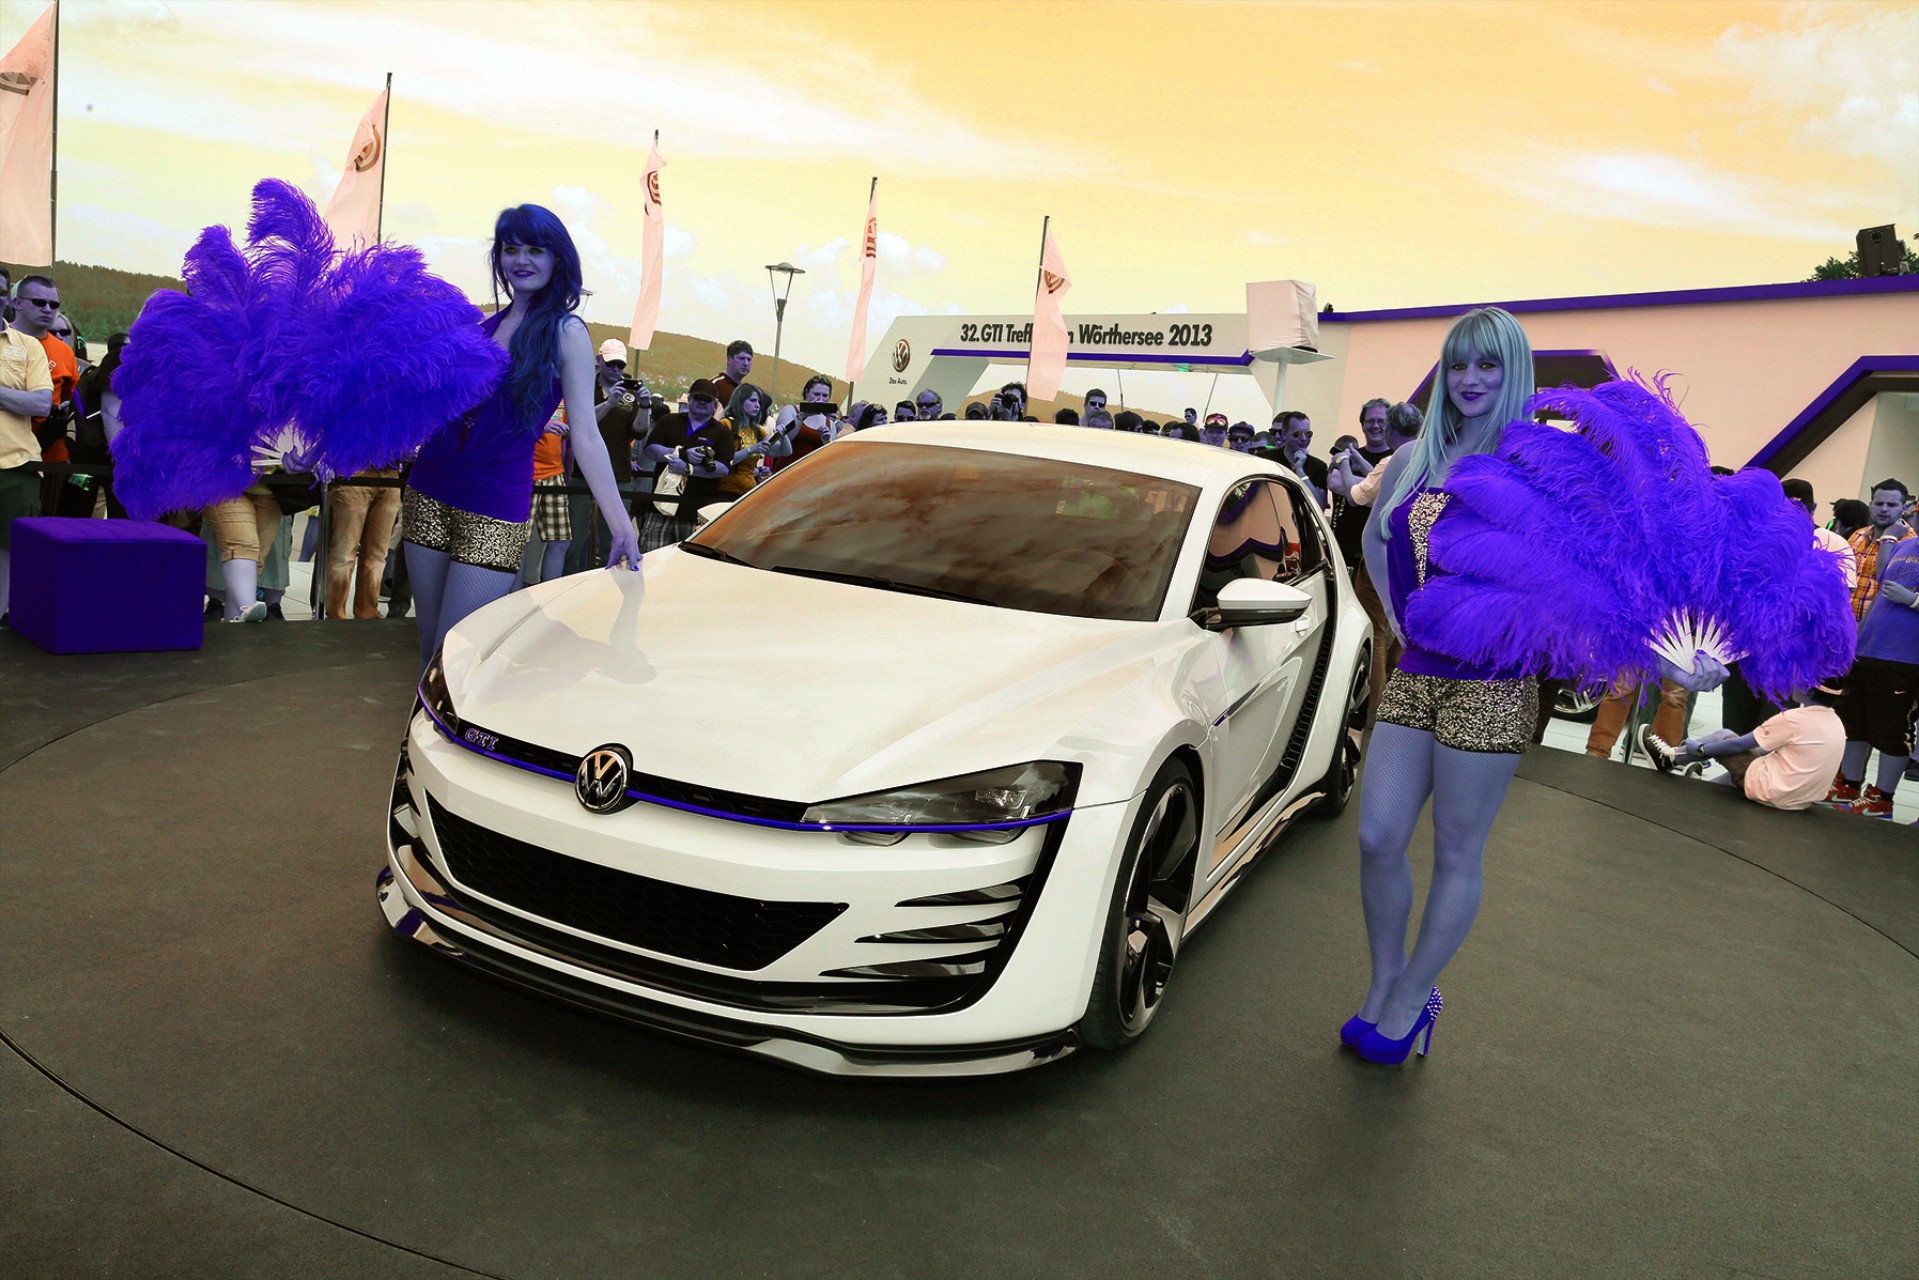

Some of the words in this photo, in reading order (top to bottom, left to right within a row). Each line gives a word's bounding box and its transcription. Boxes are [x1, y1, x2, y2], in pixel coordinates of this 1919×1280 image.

[1005, 322, 1034, 343] Treff
[1078, 323, 1164, 346] Wörthersee
[1168, 323, 1213, 346] 2013
[464, 727, 499, 751] GTI
